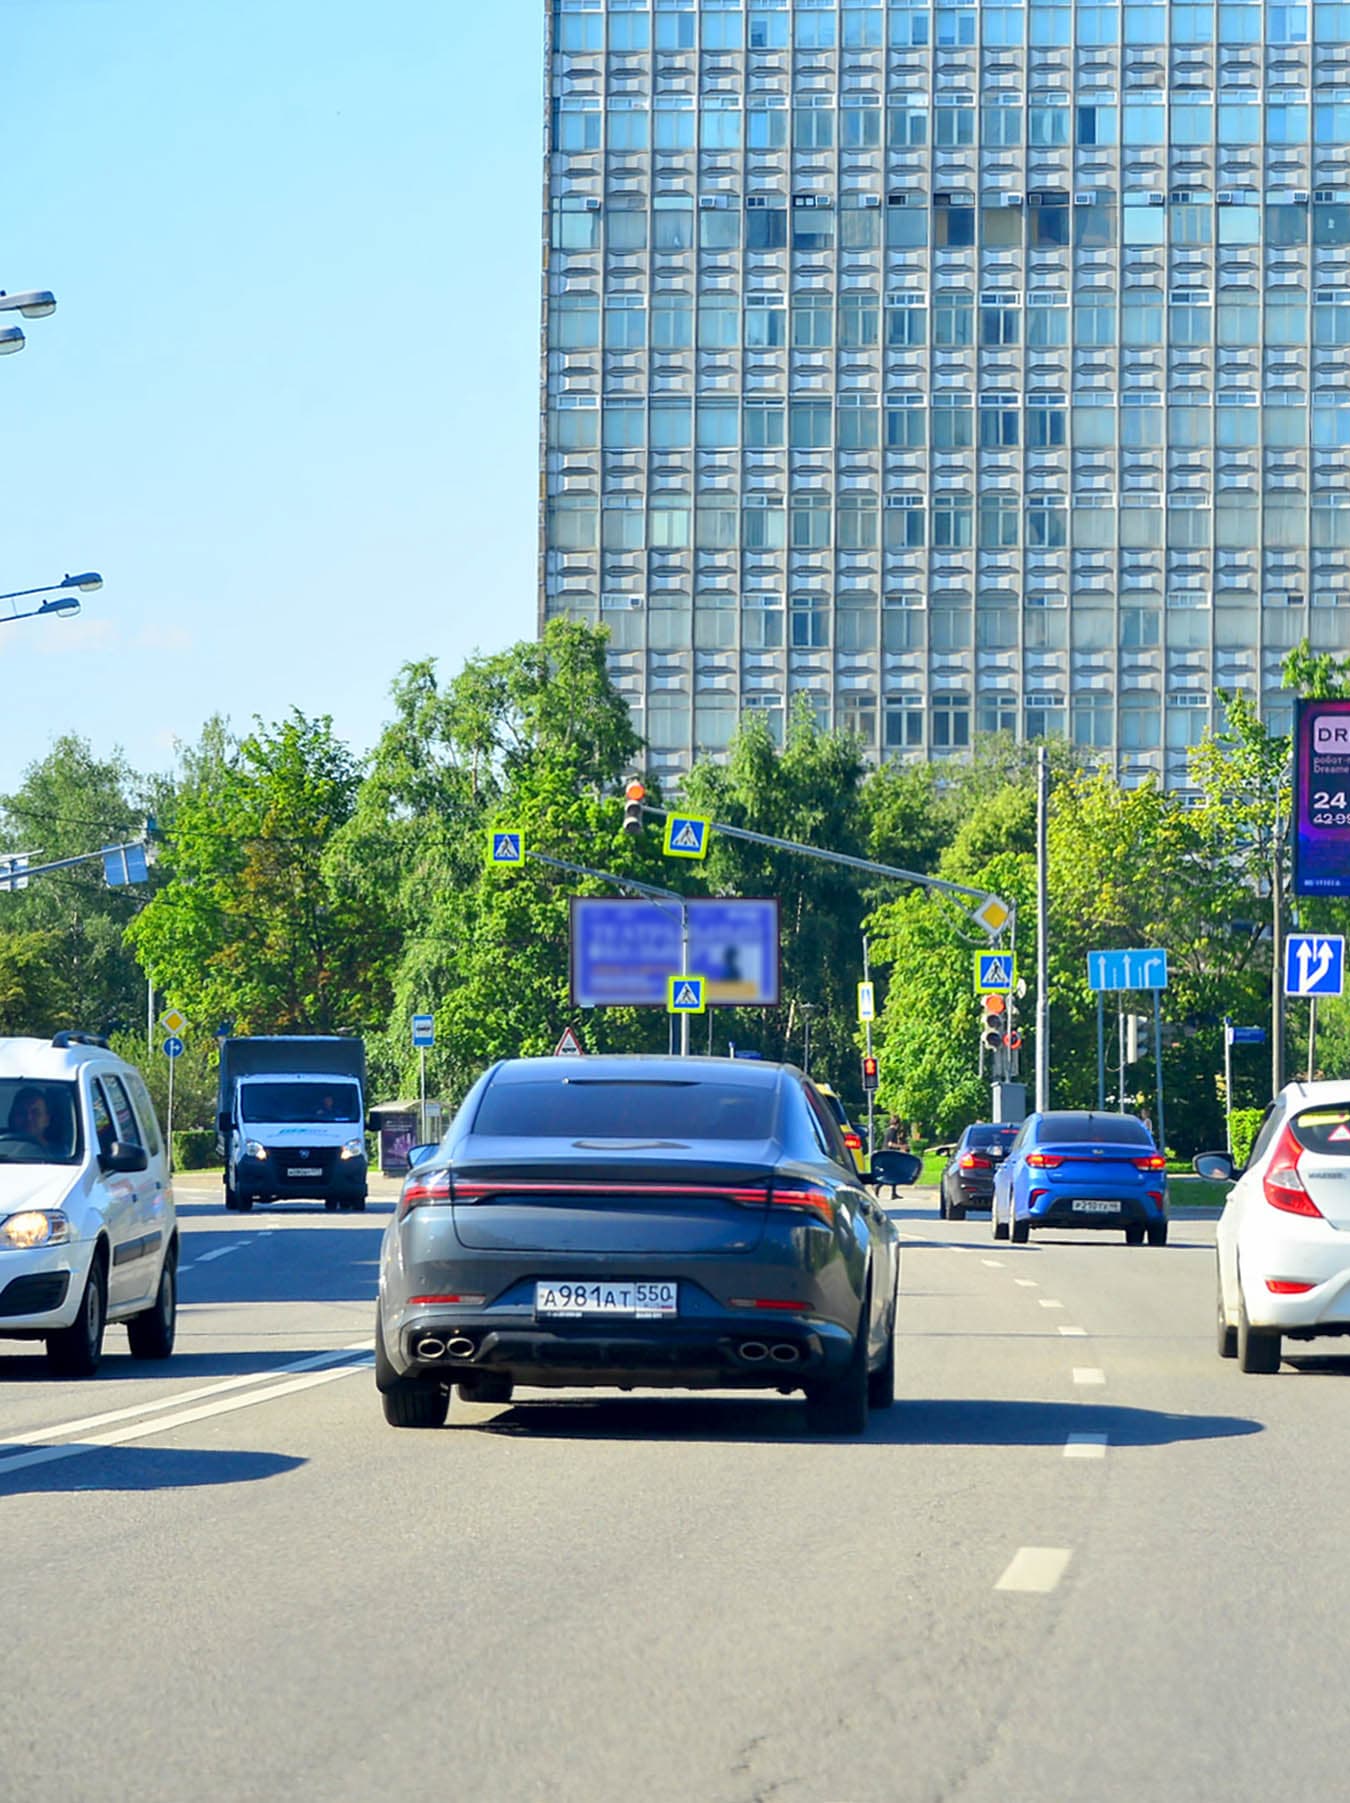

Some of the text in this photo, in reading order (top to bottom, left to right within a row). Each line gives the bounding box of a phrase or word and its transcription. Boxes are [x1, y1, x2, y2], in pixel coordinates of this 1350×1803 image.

[1313, 791, 1347, 809] 24
[544, 1285, 672, 1308] А981АТ 550
